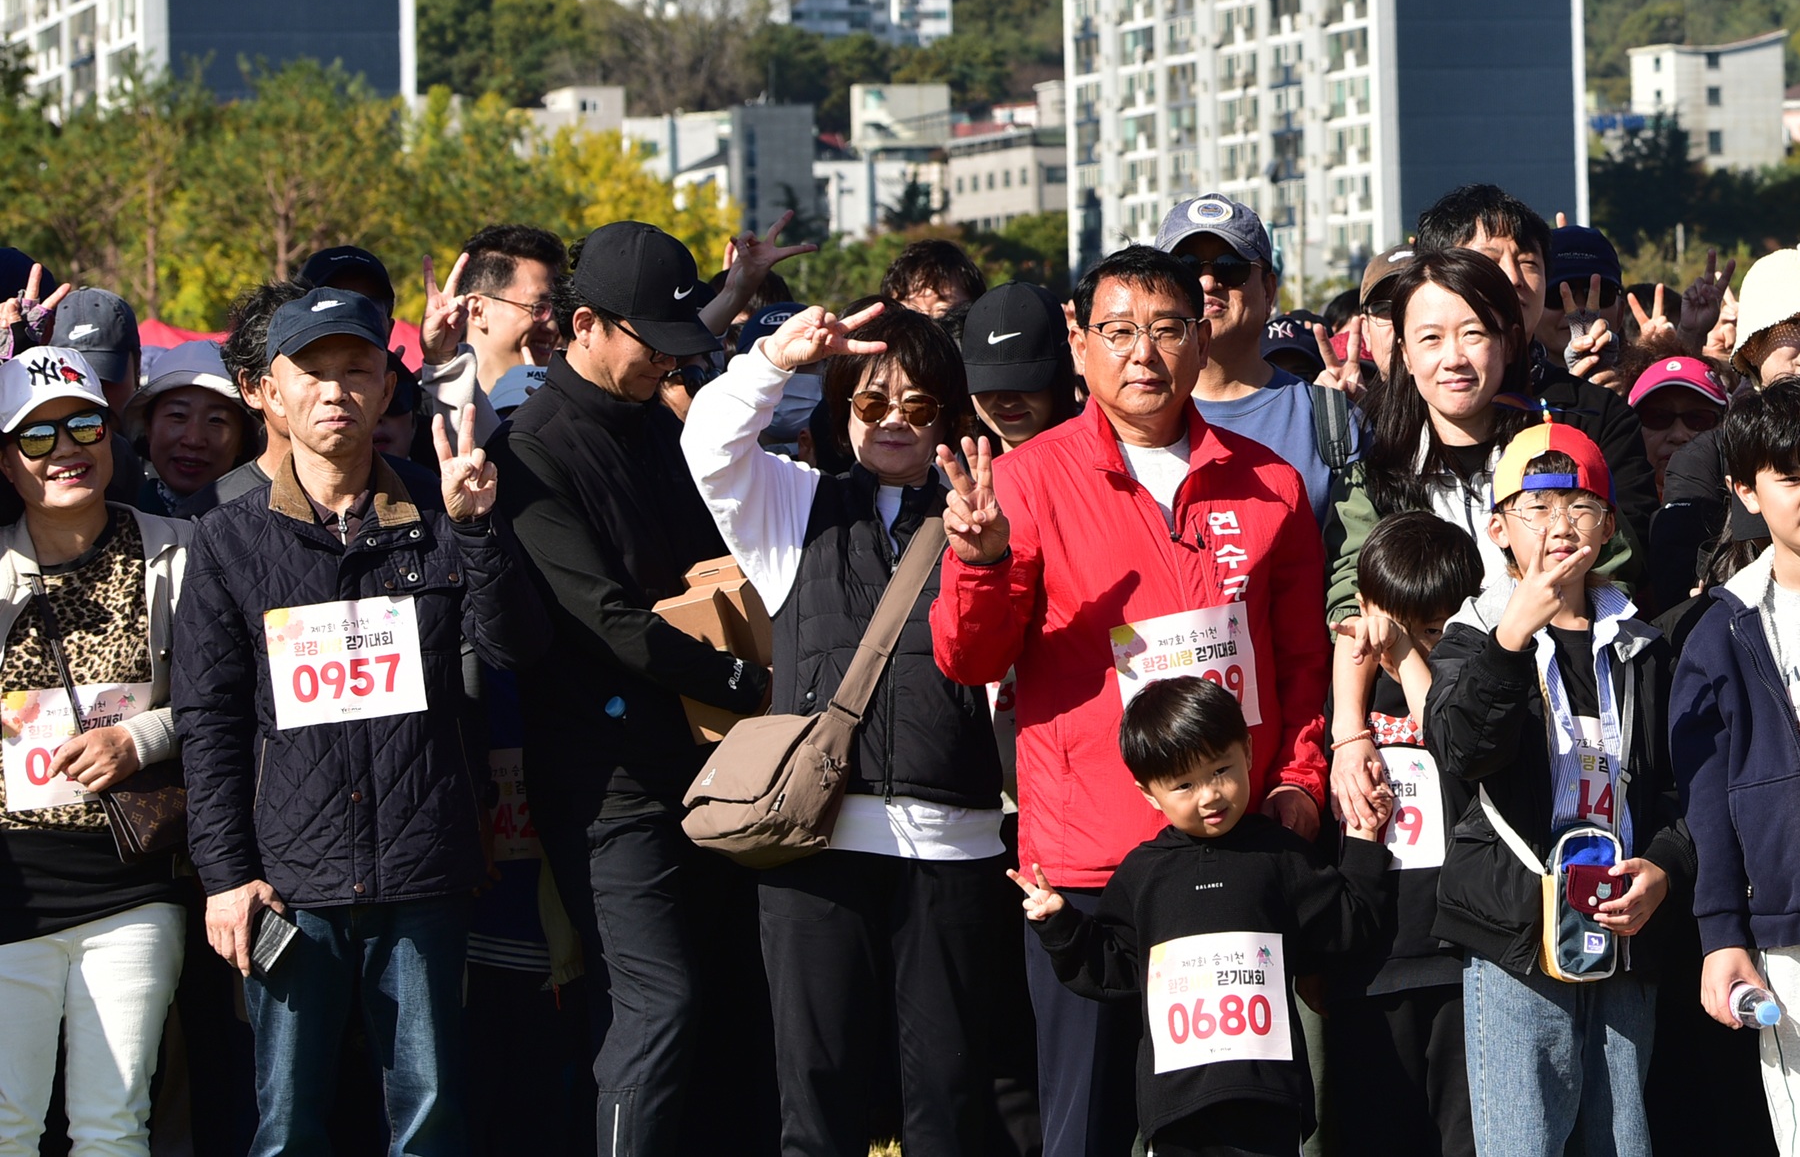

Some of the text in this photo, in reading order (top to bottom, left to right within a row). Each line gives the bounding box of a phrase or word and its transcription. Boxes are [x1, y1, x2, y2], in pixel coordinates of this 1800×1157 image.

[311, 618, 370, 634] 제7회 승기천
[1158, 626, 1218, 647] 제7회 승기천
[345, 630, 394, 651] 걷기대회
[1142, 639, 1238, 673] 환경사랑 걷기대회
[292, 653, 401, 703] 0957
[1575, 738, 1593, 748] 7회
[1182, 951, 1245, 968] 제7회 승기천
[1216, 969, 1266, 986] 걷기대회
[1167, 994, 1273, 1045] 0680
